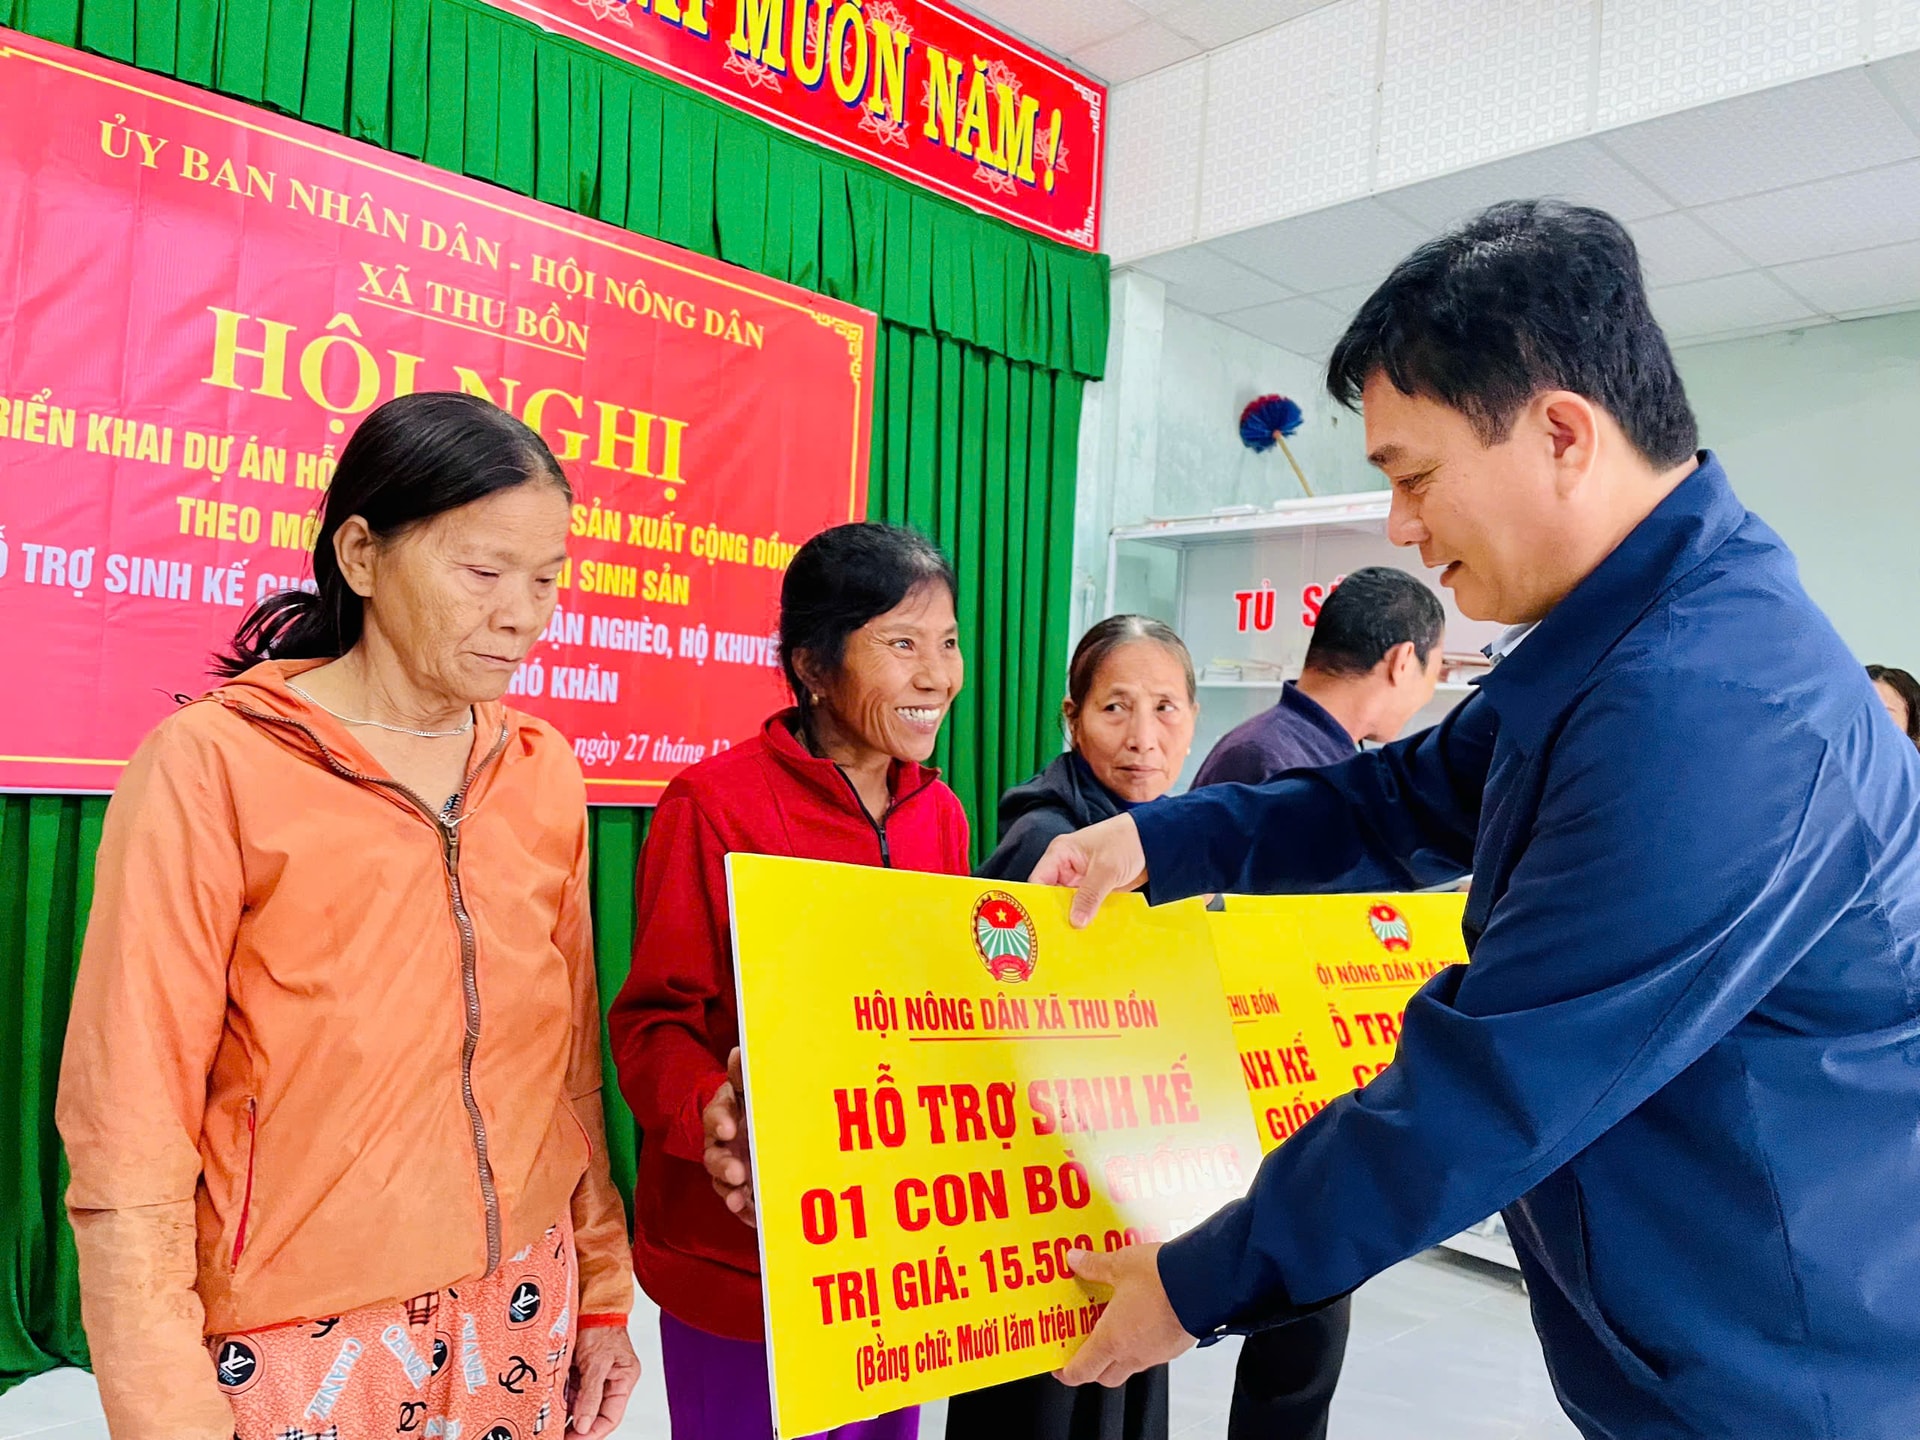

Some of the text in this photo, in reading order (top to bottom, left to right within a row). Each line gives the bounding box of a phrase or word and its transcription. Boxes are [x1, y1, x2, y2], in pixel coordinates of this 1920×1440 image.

[99, 113, 168, 169] ỦY
[179, 144, 276, 203] BAN
[287, 178, 409, 243] NHÂN
[420, 222, 502, 271] DÂN
[531, 254, 597, 301] HỘI
[605, 276, 696, 330] NÔNG
[704, 308, 766, 350] DÂN
[358, 263, 590, 352] XÃ THU BỒN
[86, 413, 173, 465] KHAI
[183, 431, 235, 483] DỰ
[238, 436, 286, 485] ÁN
[176, 496, 261, 544] THEO
[570, 497, 621, 543] SẢN
[627, 511, 686, 553] XUẤT
[690, 523, 748, 566] CỘNG
[21, 542, 96, 598] TRỢ
[104, 553, 192, 601] SINH
[201, 558, 250, 607] KẾ
[579, 560, 637, 598] SINH
[642, 562, 690, 606] SẢN
[1235, 581, 1276, 632] TỦ
[590, 616, 673, 660] NGHÈO,
[679, 623, 708, 666] HỘ
[551, 663, 618, 703] KHĂN
[574, 732, 620, 766] ngày
[624, 734, 649, 762] 27
[854, 989, 1159, 1038] HỘI NÔNG DÂN XÃ THU BỒN
[834, 1055, 1200, 1152] HỖ TRỢ SINH KẾ
[801, 1185, 867, 1245] 01
[894, 1169, 1009, 1232] CON
[1023, 1150, 1091, 1215] BÒ
[813, 1271, 881, 1328] TRỊ
[892, 1246, 969, 1311] GIÁ:
[857, 1334, 909, 1391] (Bằng
[915, 1329, 952, 1372] chữ:
[957, 1319, 999, 1362] Mười
[1004, 1313, 1035, 1352] lăm
[1039, 1303, 1075, 1348] triệu
